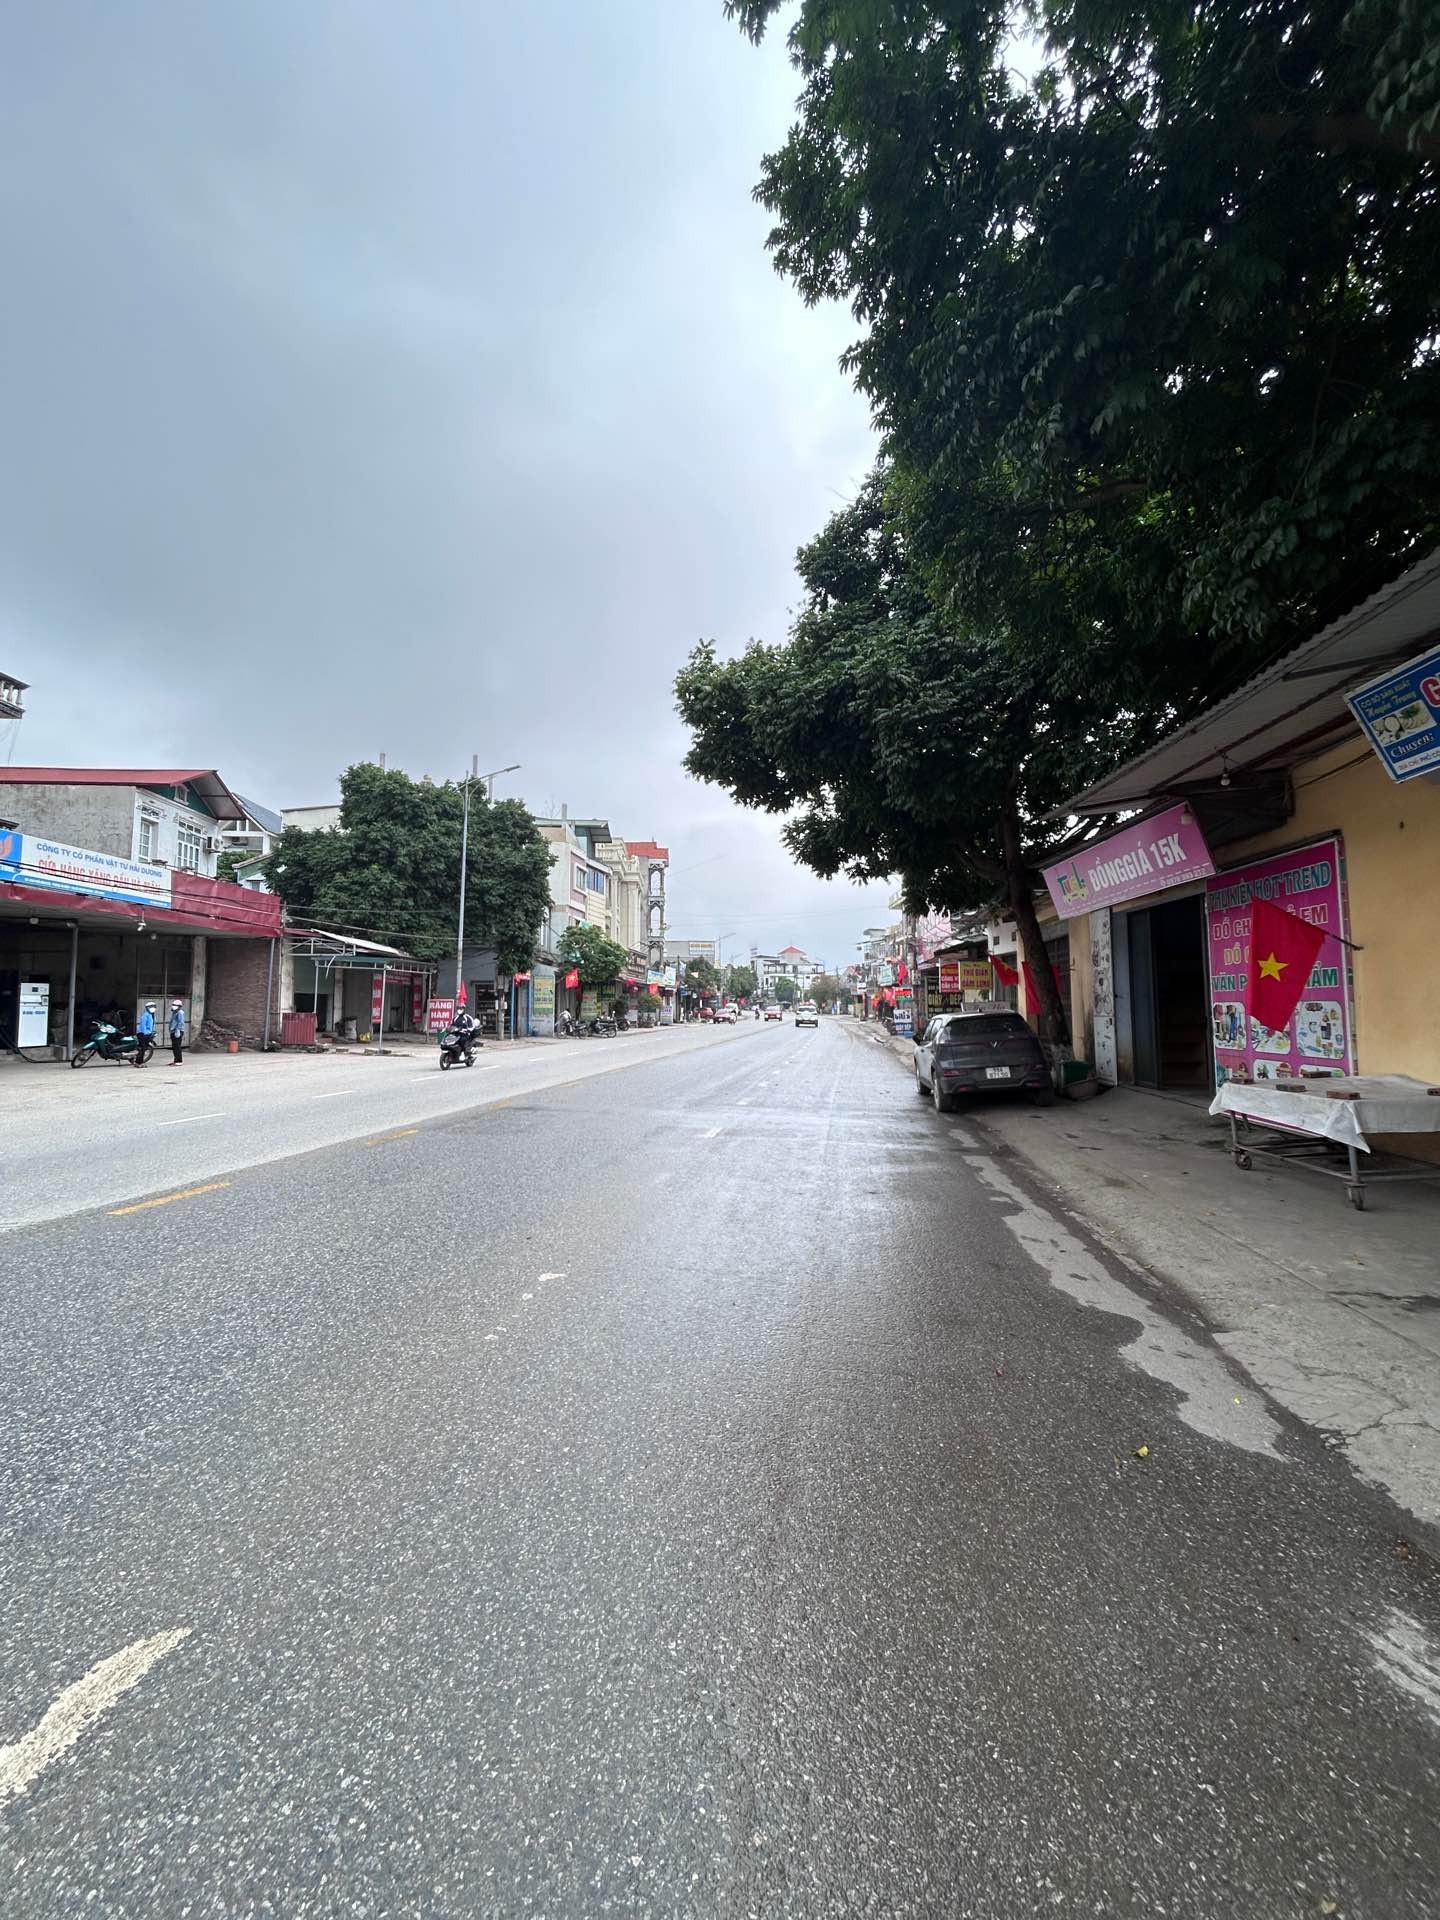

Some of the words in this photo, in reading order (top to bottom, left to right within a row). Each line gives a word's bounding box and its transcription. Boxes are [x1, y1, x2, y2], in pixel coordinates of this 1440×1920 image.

[36, 842, 60, 855] CÔNG
[61, 848, 71, 857] TY
[1150, 833, 1187, 869] 15K
[1254, 874, 1282, 901] HOT
[1282, 860, 1332, 895] TREND
[1211, 971, 1236, 992] VĂN
